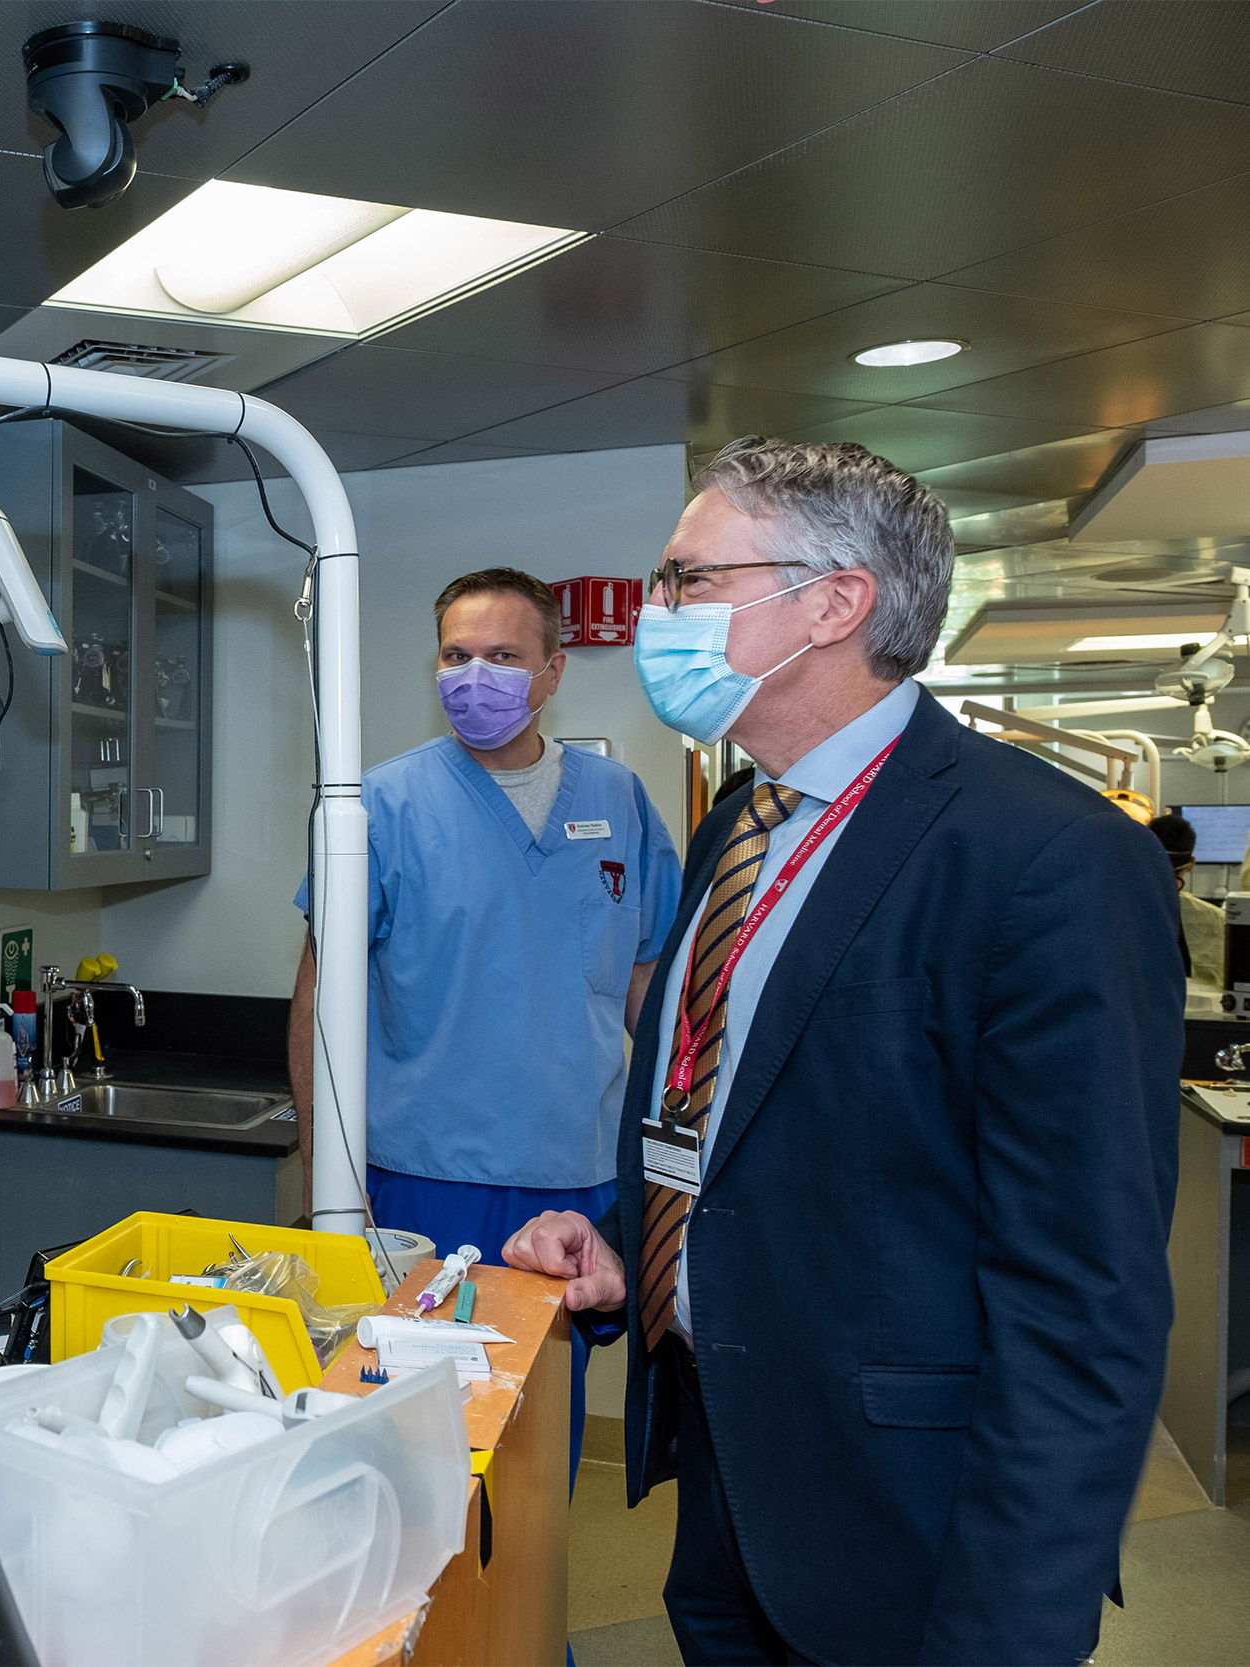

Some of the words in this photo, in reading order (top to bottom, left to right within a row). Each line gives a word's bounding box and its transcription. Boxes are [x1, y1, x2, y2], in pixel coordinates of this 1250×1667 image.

[591, 623, 626, 631] EXTINGUISHER
[603, 616, 614, 624] FIRE
[840, 783, 865, 806] School
[833, 804, 842, 816] of
[814, 812, 838, 836] Dental
[790, 834, 817, 866] Medicine
[737, 903, 768, 947] HARVARD
[678, 1055, 692, 1081] School
